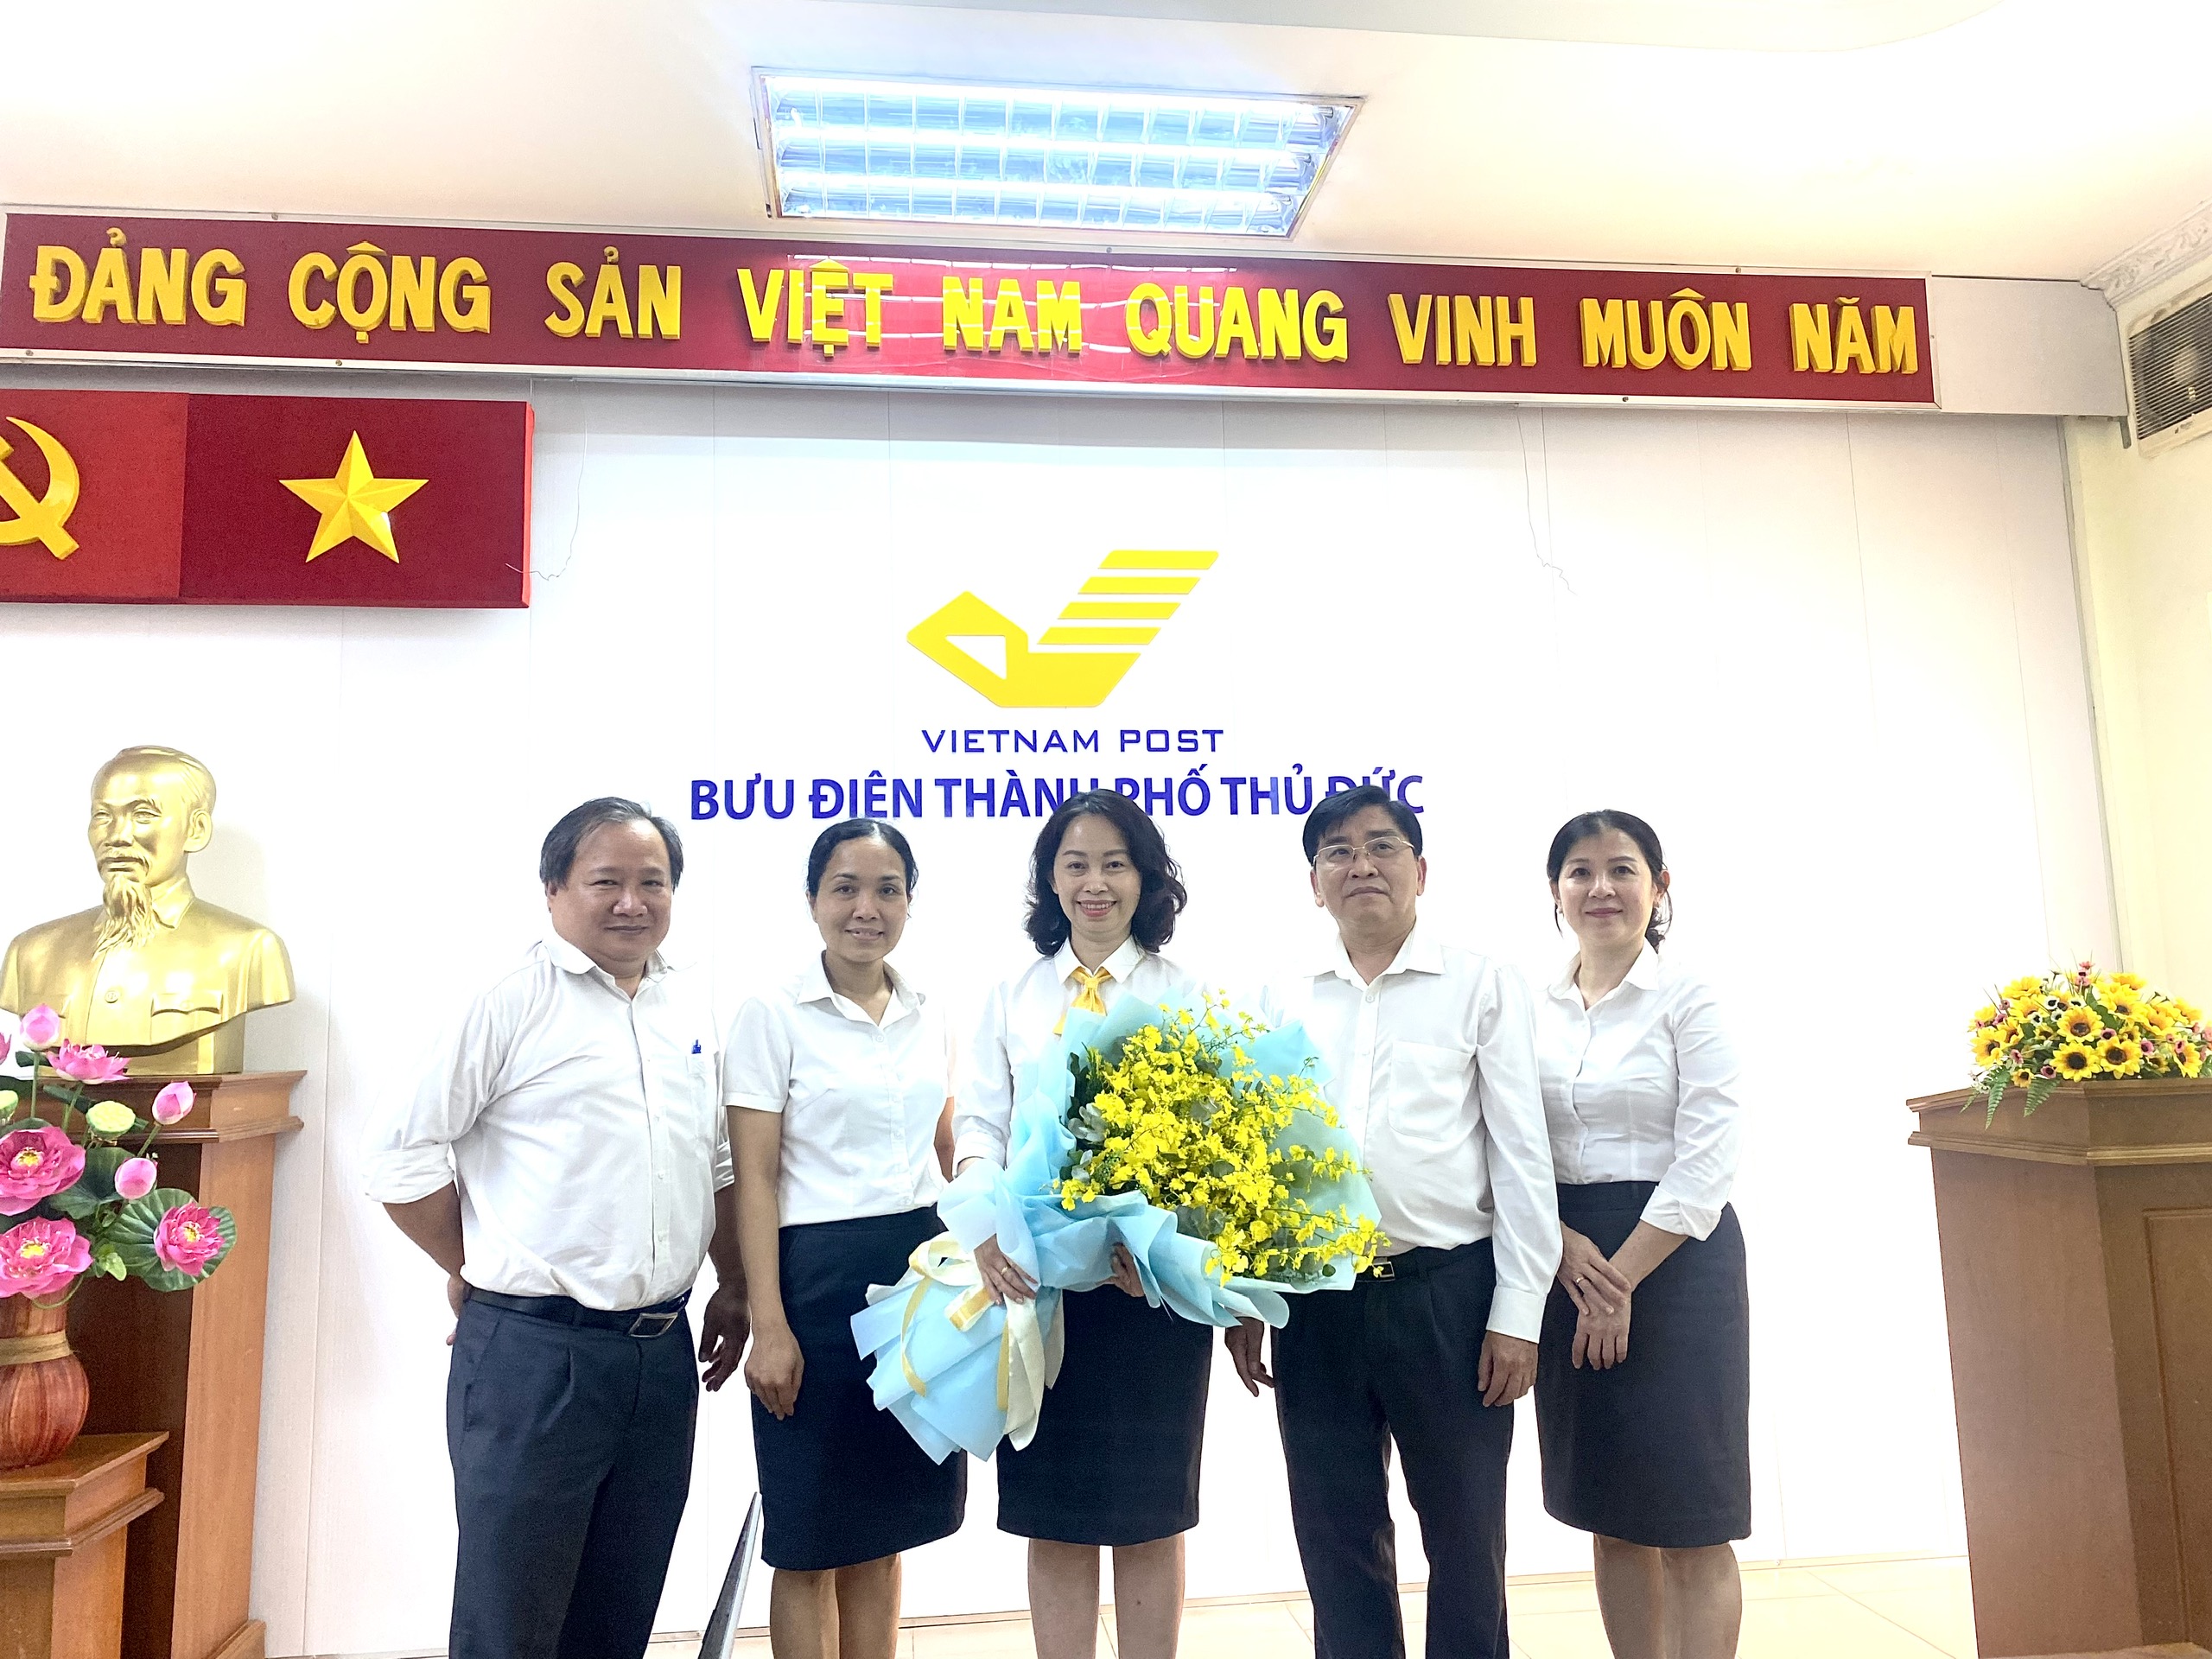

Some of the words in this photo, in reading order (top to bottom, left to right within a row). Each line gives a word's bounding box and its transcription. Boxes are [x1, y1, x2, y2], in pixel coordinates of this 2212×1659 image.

[30, 228, 245, 326] ĐẢNG
[289, 240, 489, 343] CỘNG
[546, 248, 681, 338] SẢN
[737, 258, 893, 356] VIỆT
[943, 277, 1082, 352] NAM
[1126, 283, 1347, 362] QUANG
[1389, 295, 1536, 365] VINH
[1581, 289, 1751, 370] MUÔN
[1791, 298, 1917, 373] NĂM
[922, 730, 1098, 752] VIETNAM
[1121, 730, 1224, 752] POST
[691, 773, 793, 820] BƯU
[1221, 764, 1312, 815] THỦ
